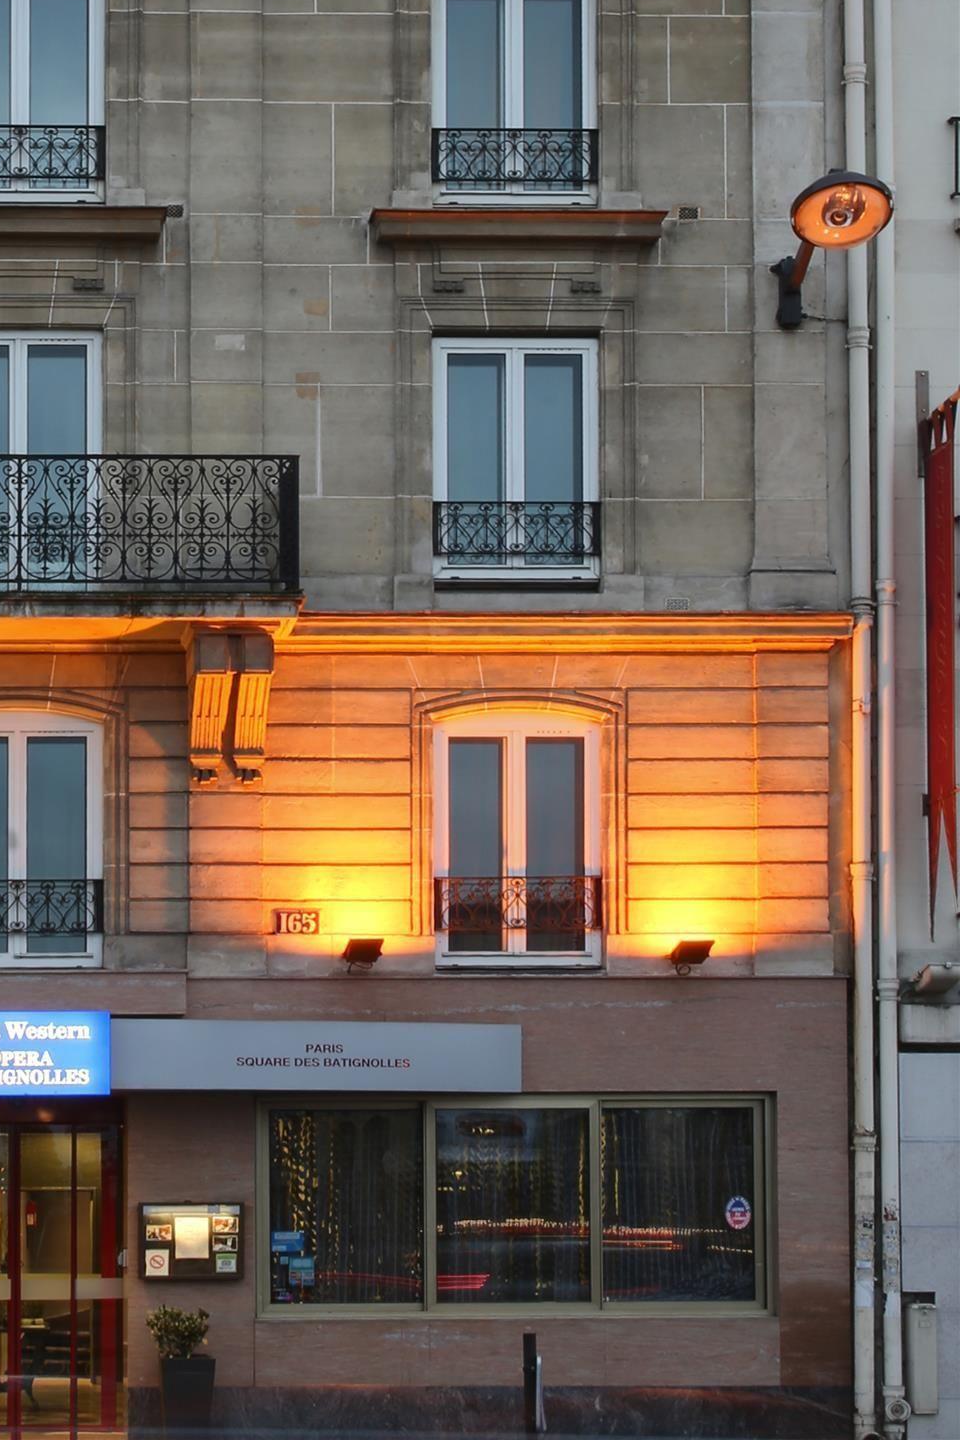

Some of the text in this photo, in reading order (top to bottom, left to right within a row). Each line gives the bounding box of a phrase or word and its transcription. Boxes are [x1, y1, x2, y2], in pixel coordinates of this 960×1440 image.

[279, 912, 317, 934] 165
[4, 1020, 91, 1041] Western
[305, 1043, 344, 1054] PARIS
[236, 1056, 411, 1069] SQUARE DES BATIGNOLLES
